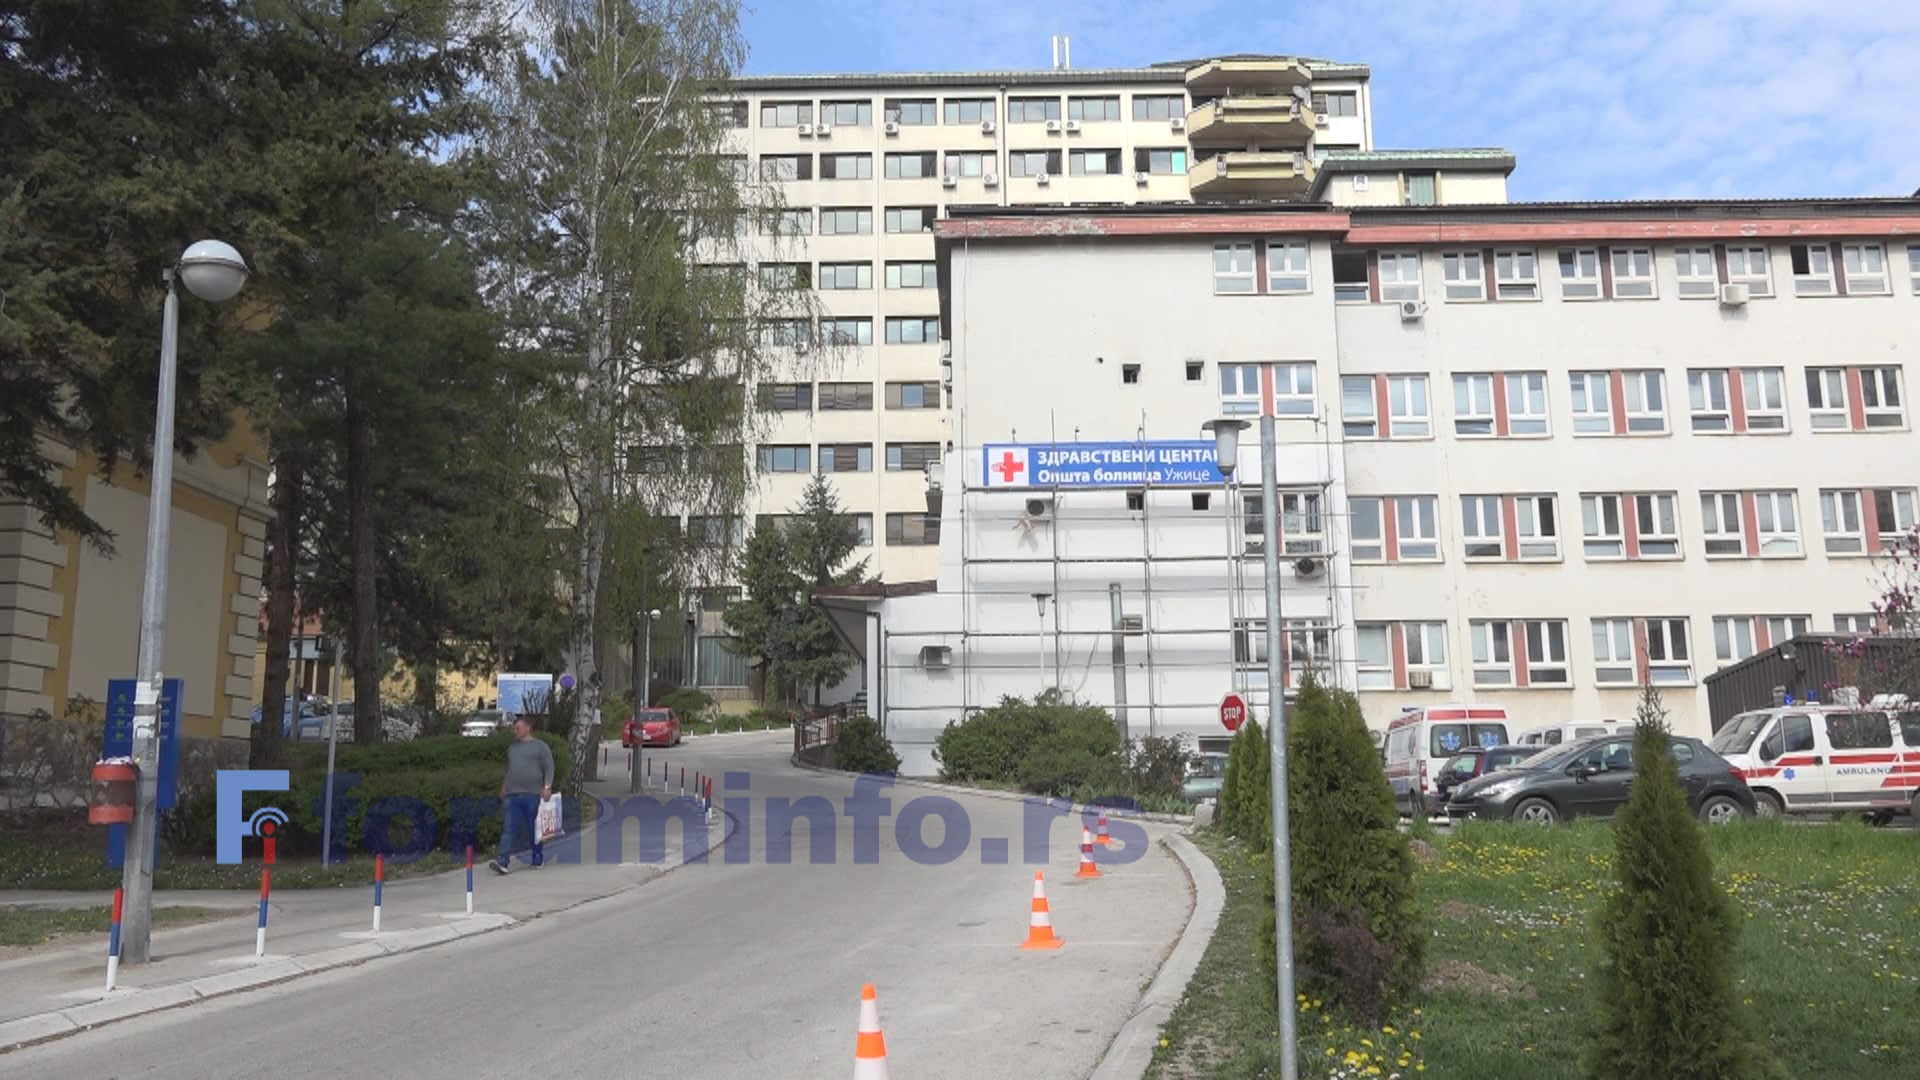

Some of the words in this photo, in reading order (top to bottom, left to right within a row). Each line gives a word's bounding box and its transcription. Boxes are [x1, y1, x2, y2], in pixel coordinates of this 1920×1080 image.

[1037, 449, 1156, 466] ЗДРАВСТВЕНИ
[1038, 470, 1090, 484] Општа
[1093, 468, 1162, 484] болница
[1164, 467, 1210, 483] Ужице
[1223, 706, 1241, 721] STOP
